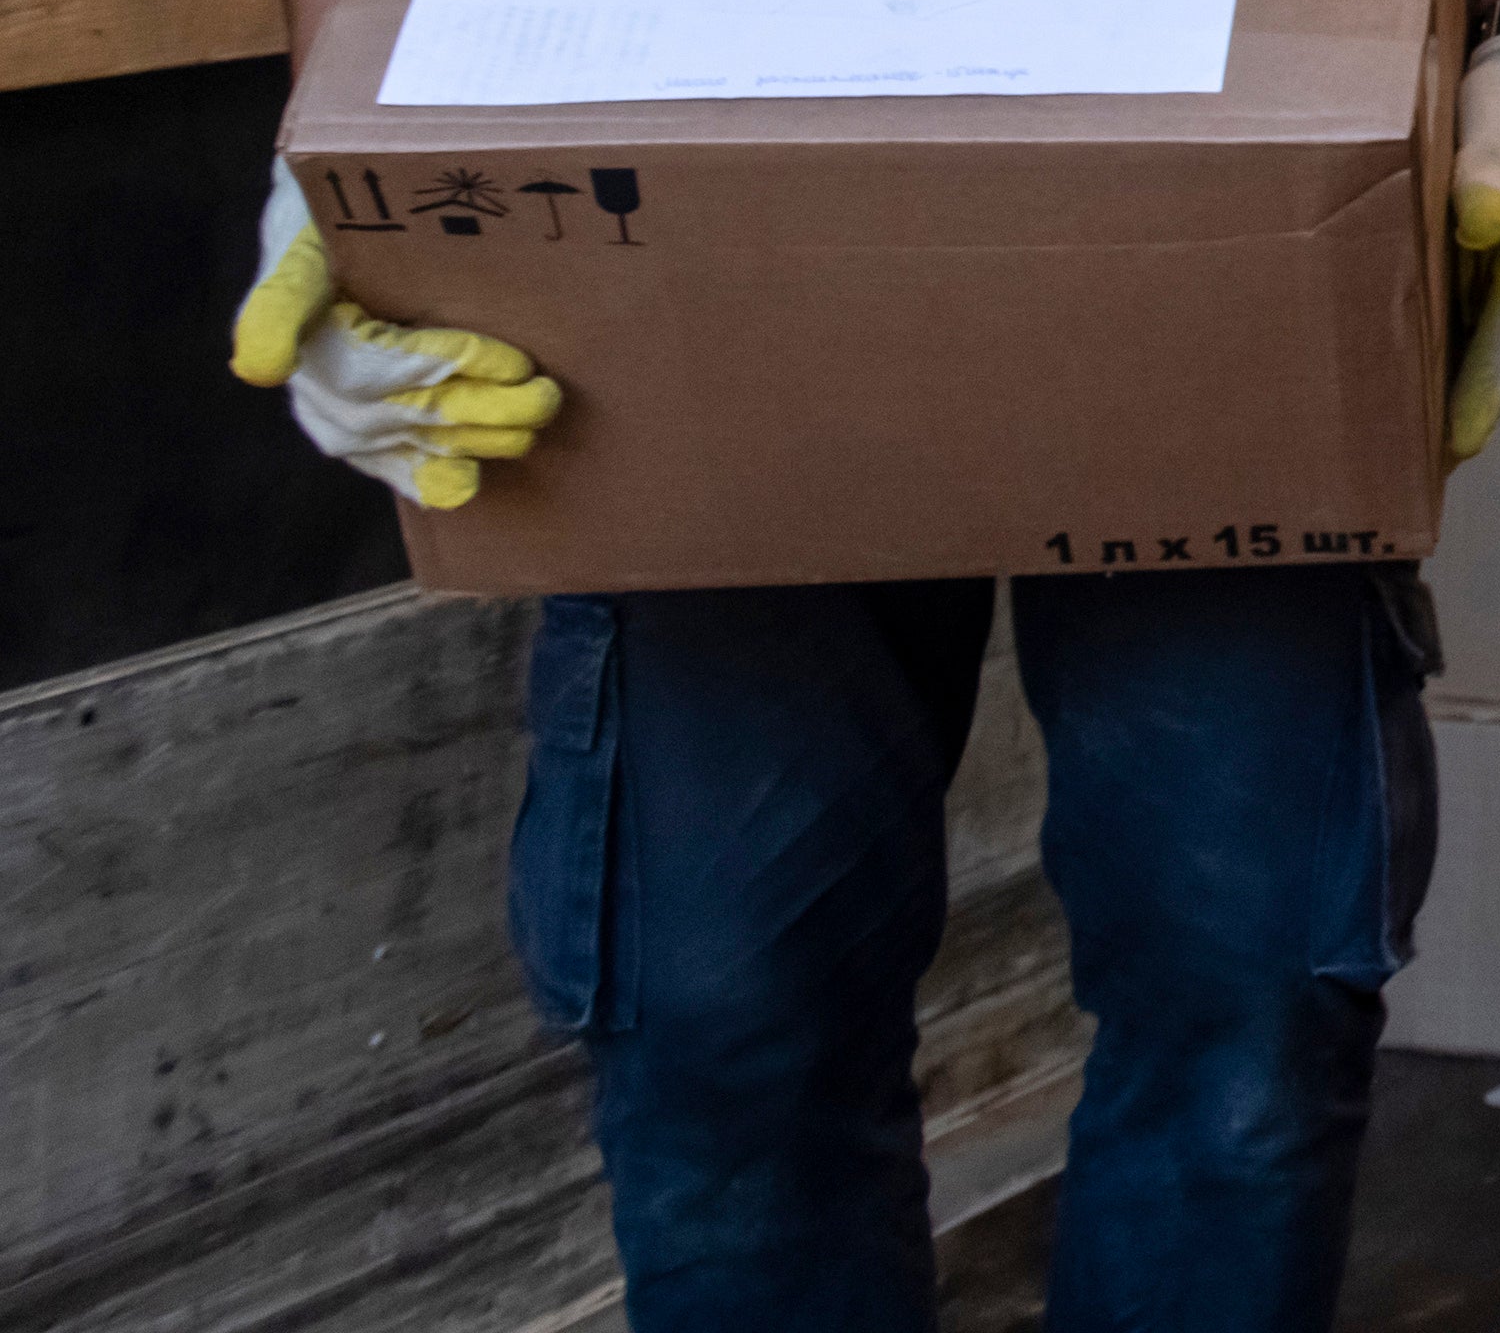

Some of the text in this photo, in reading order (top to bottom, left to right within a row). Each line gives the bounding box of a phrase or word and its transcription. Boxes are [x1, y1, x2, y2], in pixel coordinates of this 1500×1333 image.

[1045, 532, 1075, 566] 1
[1098, 532, 1140, 565] л
[1213, 525, 1280, 560] 15
[1303, 524, 1398, 558] шт.
